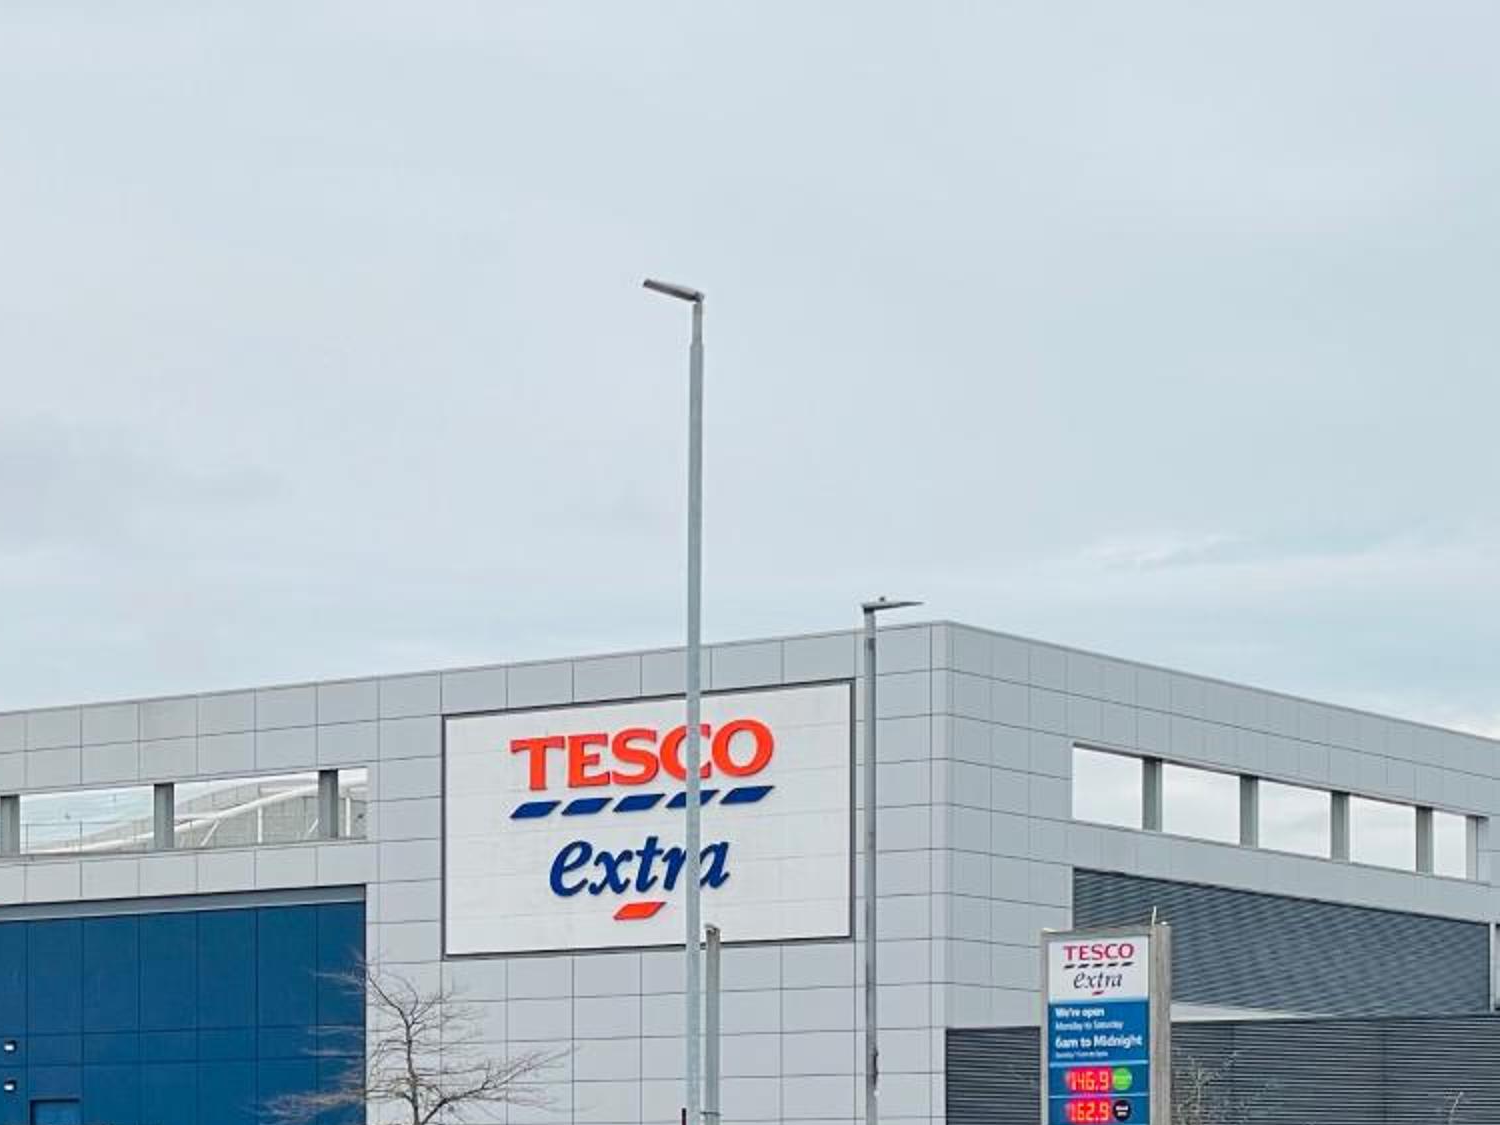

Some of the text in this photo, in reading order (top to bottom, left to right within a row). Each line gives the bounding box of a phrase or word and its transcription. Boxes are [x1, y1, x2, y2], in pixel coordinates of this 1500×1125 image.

[510, 719, 774, 791] TESCO
[549, 836, 730, 897] extra
[1063, 943, 1135, 960] TESCO
[1073, 972, 1122, 989] extra
[1082, 1009, 1105, 1019] open
[1055, 1034, 1142, 1049] 6am to Midnight
[1071, 1102, 1109, 1121] 162.9
